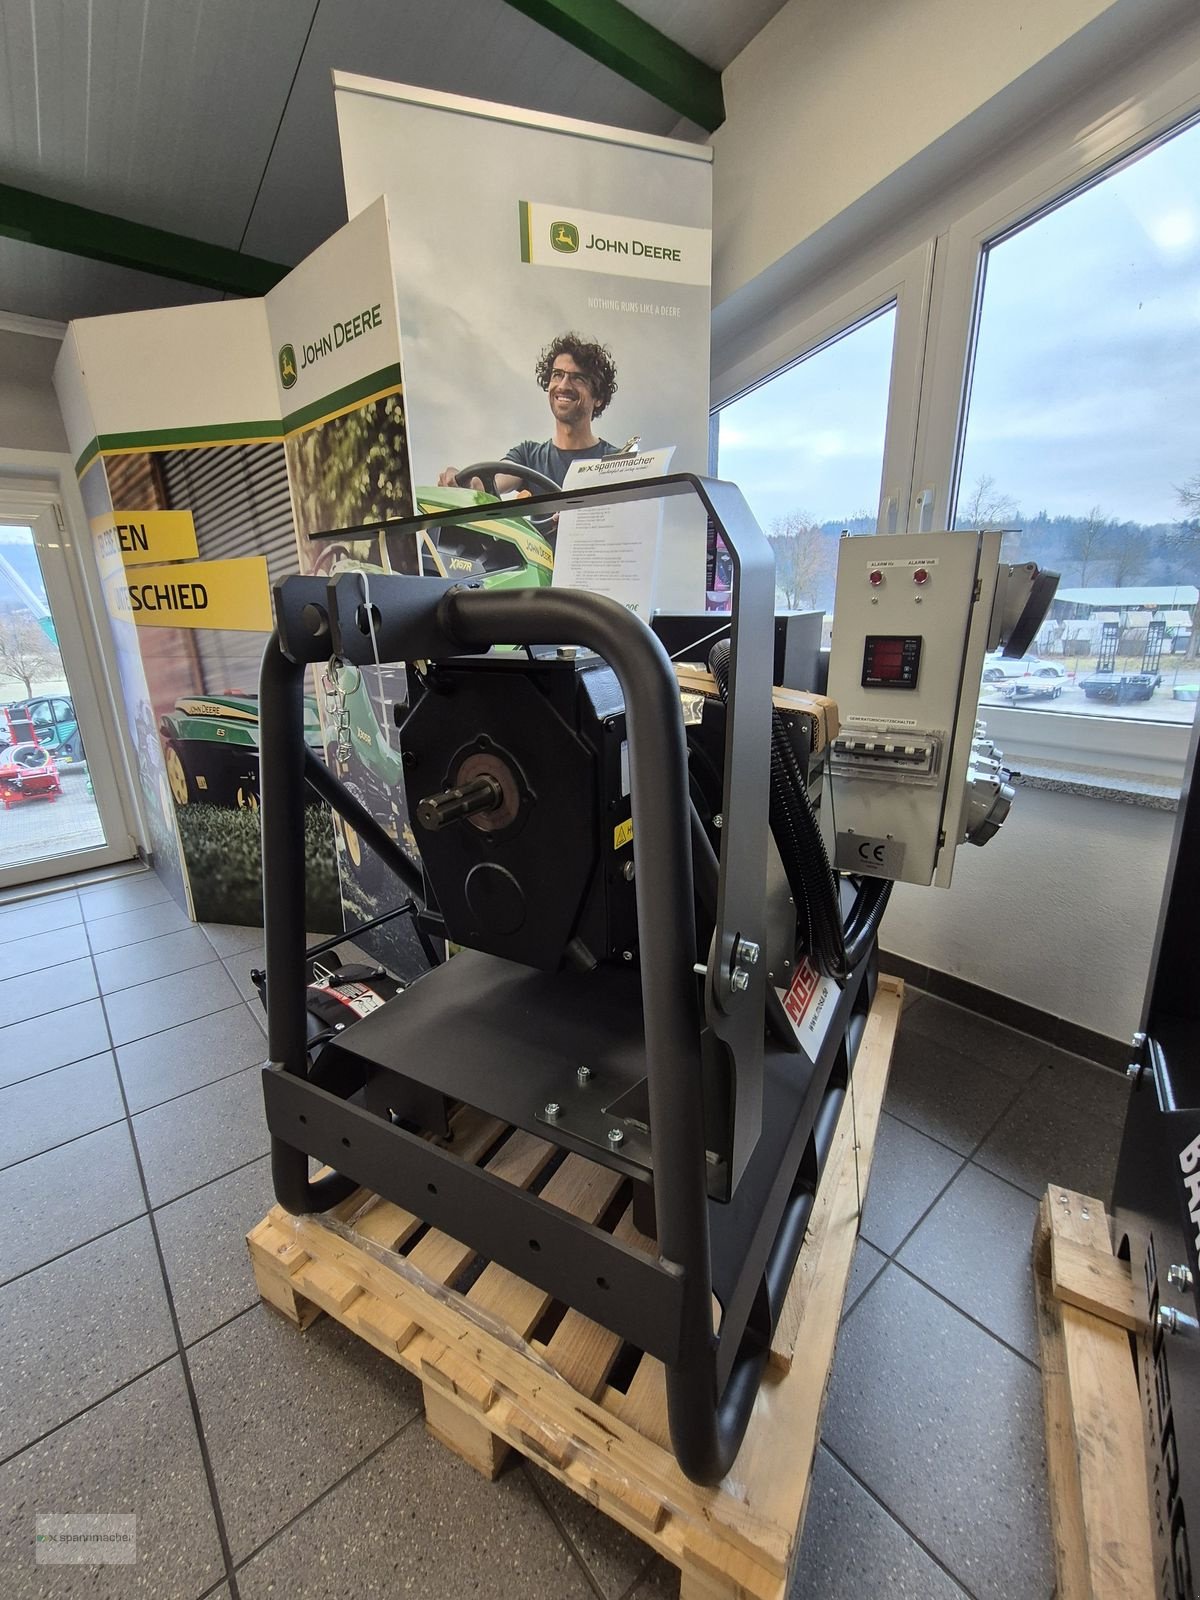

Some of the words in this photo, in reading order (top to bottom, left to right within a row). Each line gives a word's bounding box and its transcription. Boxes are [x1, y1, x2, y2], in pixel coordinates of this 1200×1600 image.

[586, 234, 628, 254] JOHN
[632, 241, 681, 262] DEERE
[588, 297, 620, 311] NOTHING
[621, 301, 639, 312] RUNS
[640, 303, 654, 315] LIKE
[655, 306, 660, 315] A
[661, 305, 681, 318] DEERE
[301, 333, 333, 369] JOHN
[333, 303, 382, 349] DEERE
[594, 456, 655, 472] spannmacher
[202, 704, 221, 715] DEERE
[785, 962, 818, 1024] MOS
